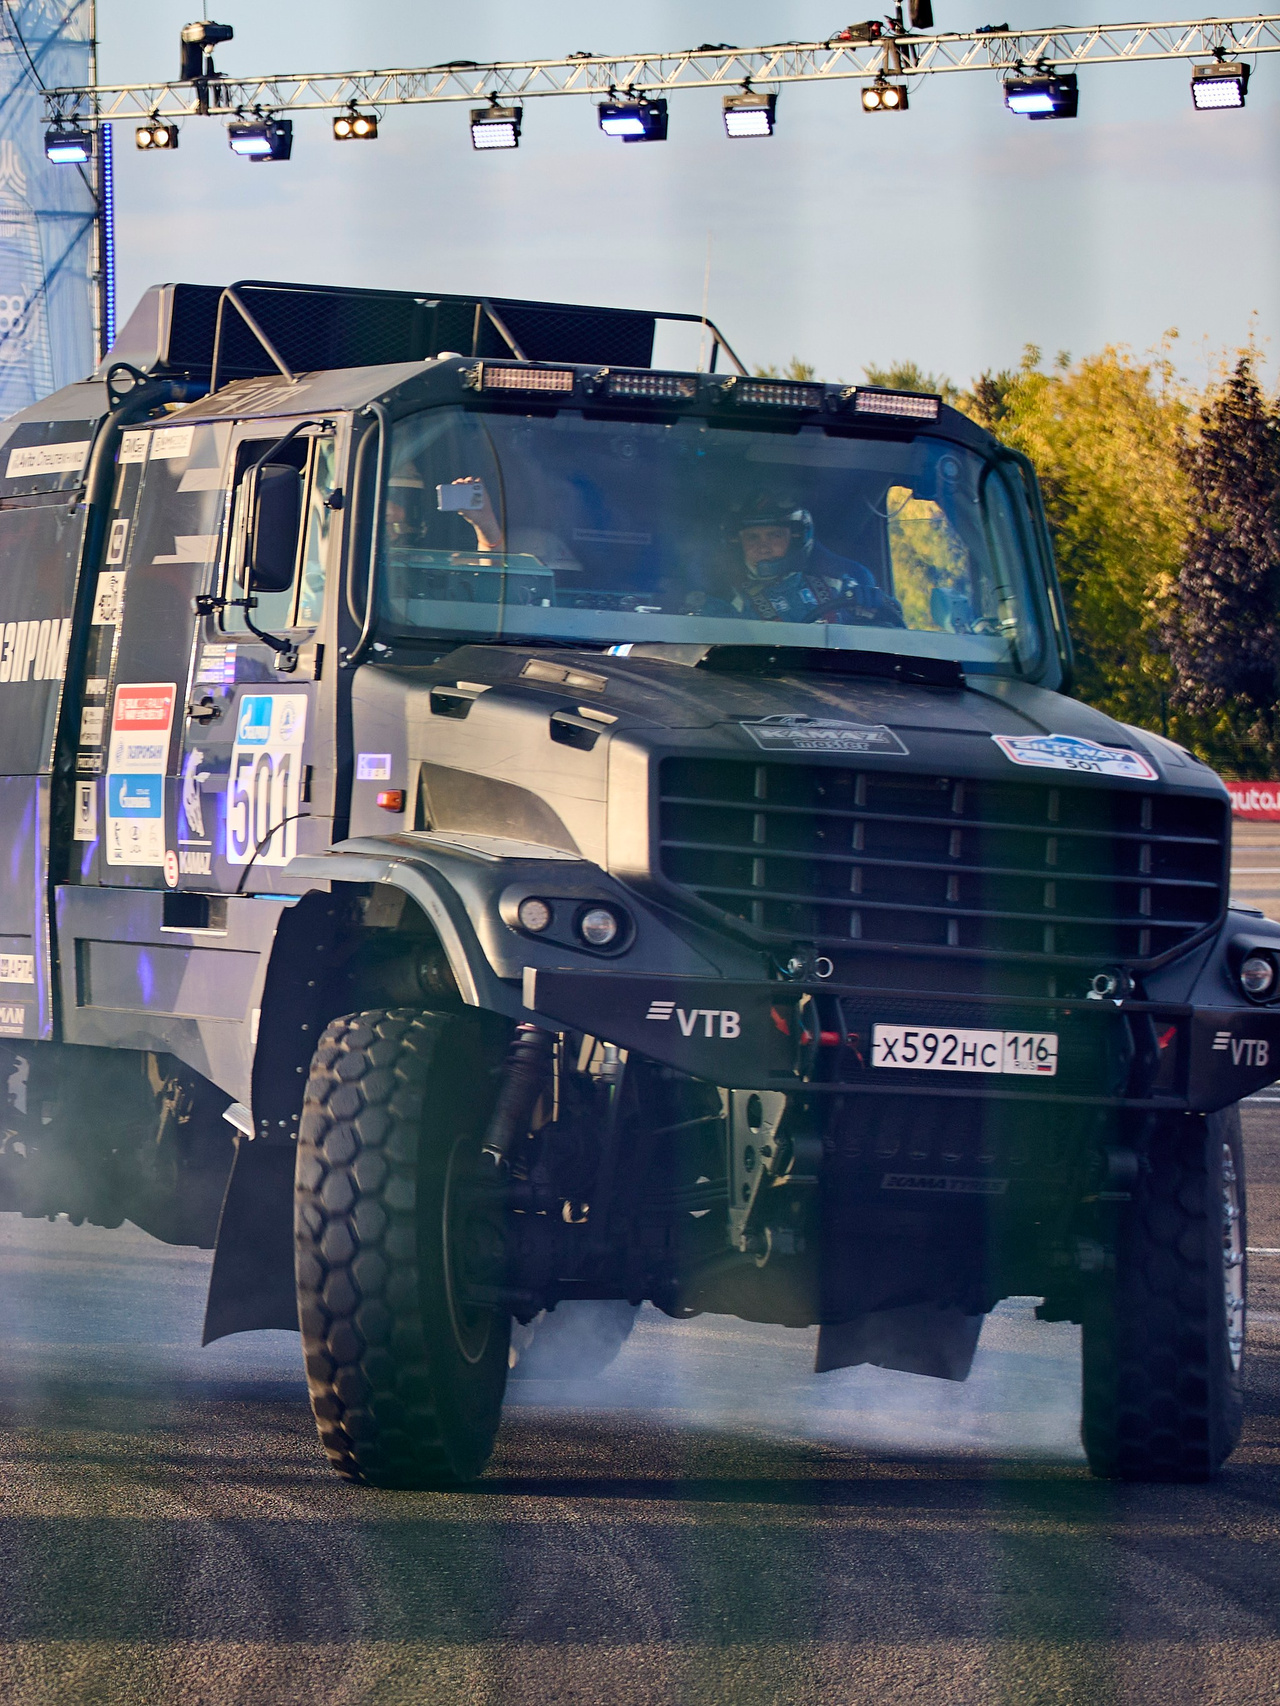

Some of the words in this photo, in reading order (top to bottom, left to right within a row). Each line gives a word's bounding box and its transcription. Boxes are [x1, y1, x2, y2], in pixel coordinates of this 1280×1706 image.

[1014, 740, 1070, 753] SILK
[1074, 746, 1126, 761] WAY
[1066, 760, 1102, 772] 501
[230, 753, 292, 858] 501
[676, 1008, 741, 1038] VTB
[1007, 1035, 1048, 1062] 116
[1231, 1038, 1270, 1067] VTB
[1014, 1061, 1037, 1071] RUS
